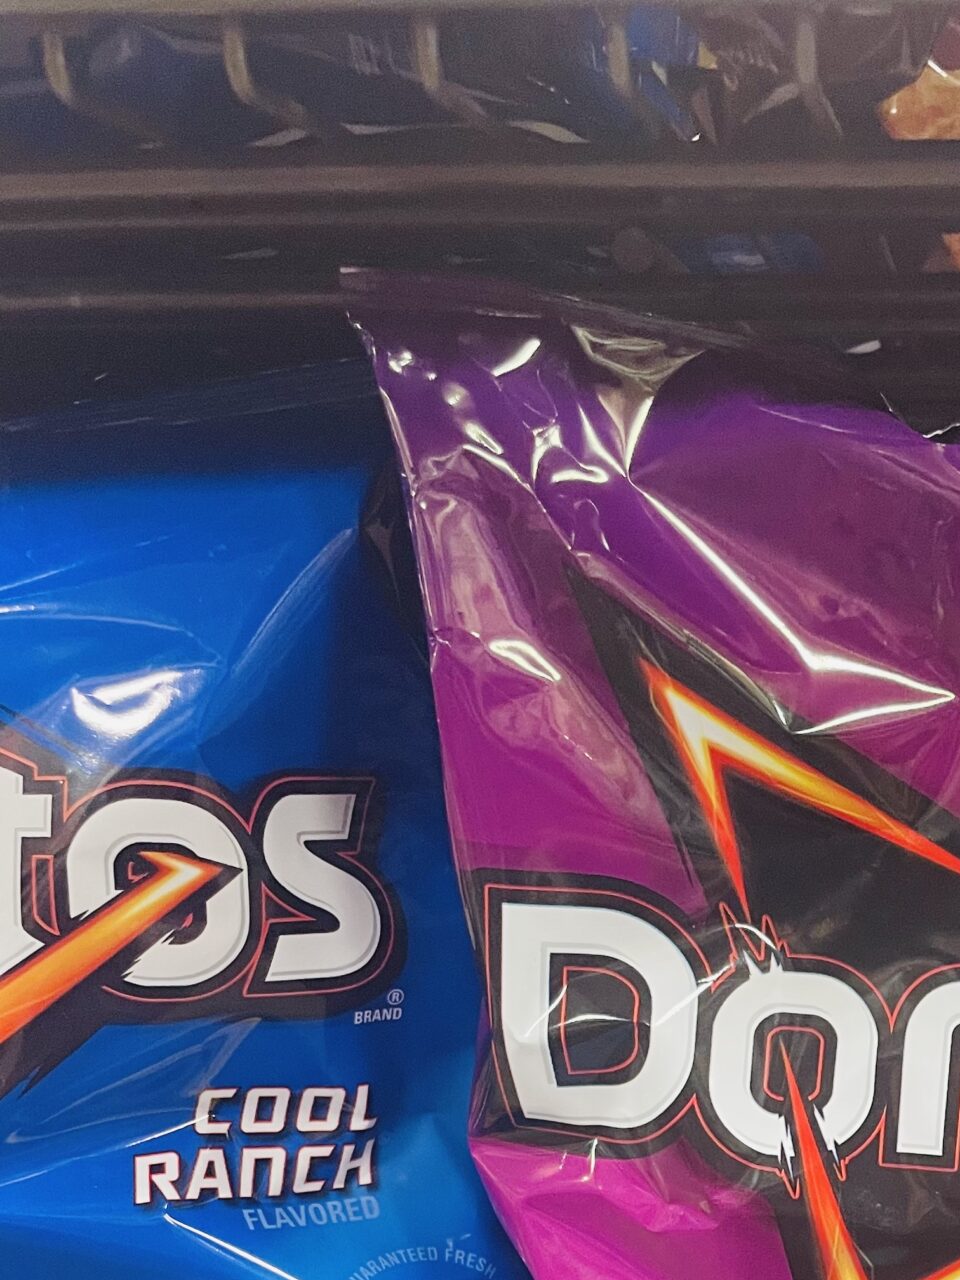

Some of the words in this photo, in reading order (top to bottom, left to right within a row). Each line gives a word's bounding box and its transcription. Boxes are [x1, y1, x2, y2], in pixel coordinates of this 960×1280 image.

[353, 1006, 402, 1026] BRAND
[194, 1083, 378, 1137] COOL
[133, 1138, 376, 1207] RANCH
[243, 1195, 380, 1232] FLAVORED
[444, 1248, 497, 1279] FRESH
